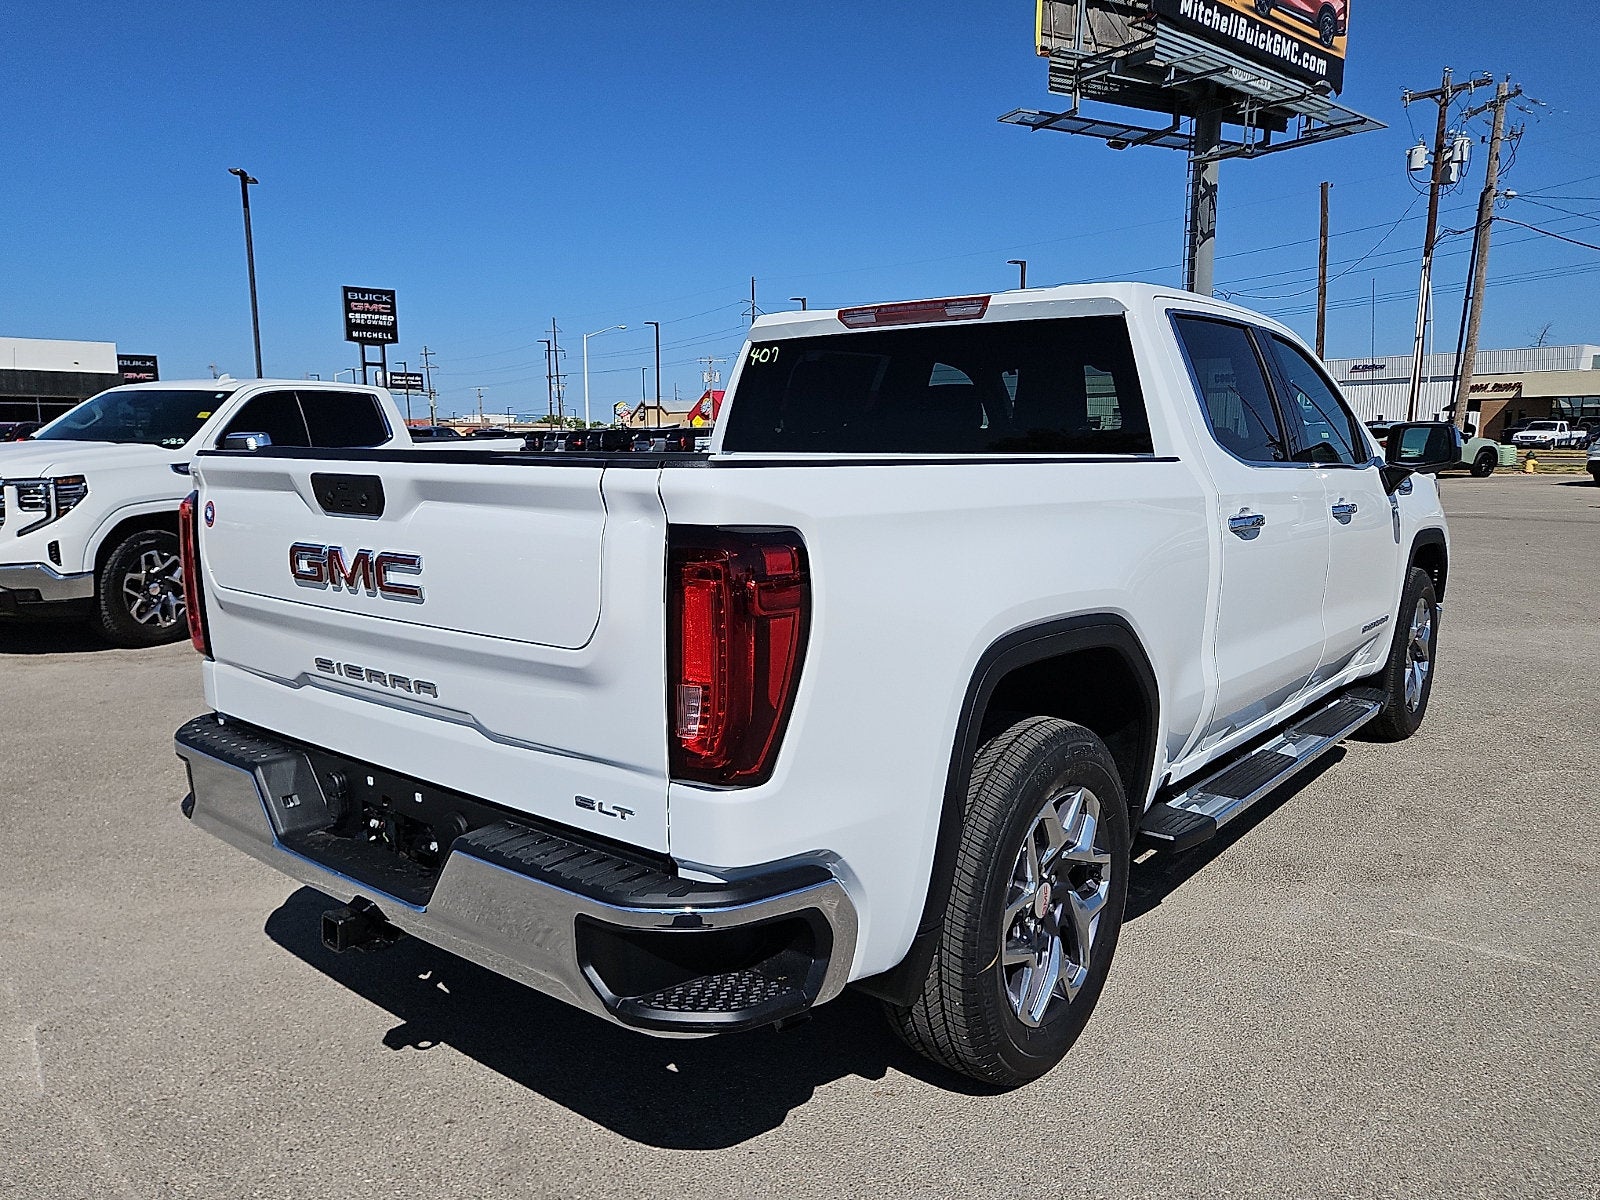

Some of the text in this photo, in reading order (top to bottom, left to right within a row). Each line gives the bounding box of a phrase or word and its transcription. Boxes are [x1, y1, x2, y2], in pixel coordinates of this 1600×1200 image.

[1180, 0, 1327, 76] MitchellBuickGMC.com
[347, 292, 392, 302] BUICK
[351, 302, 391, 312] GMC
[348, 313, 394, 321] CERTIFIED
[352, 331, 393, 339] MITCHELL
[750, 346, 779, 366] 407
[288, 541, 426, 605] GMC
[314, 656, 439, 699] SIERRA
[574, 795, 636, 821] SLT
